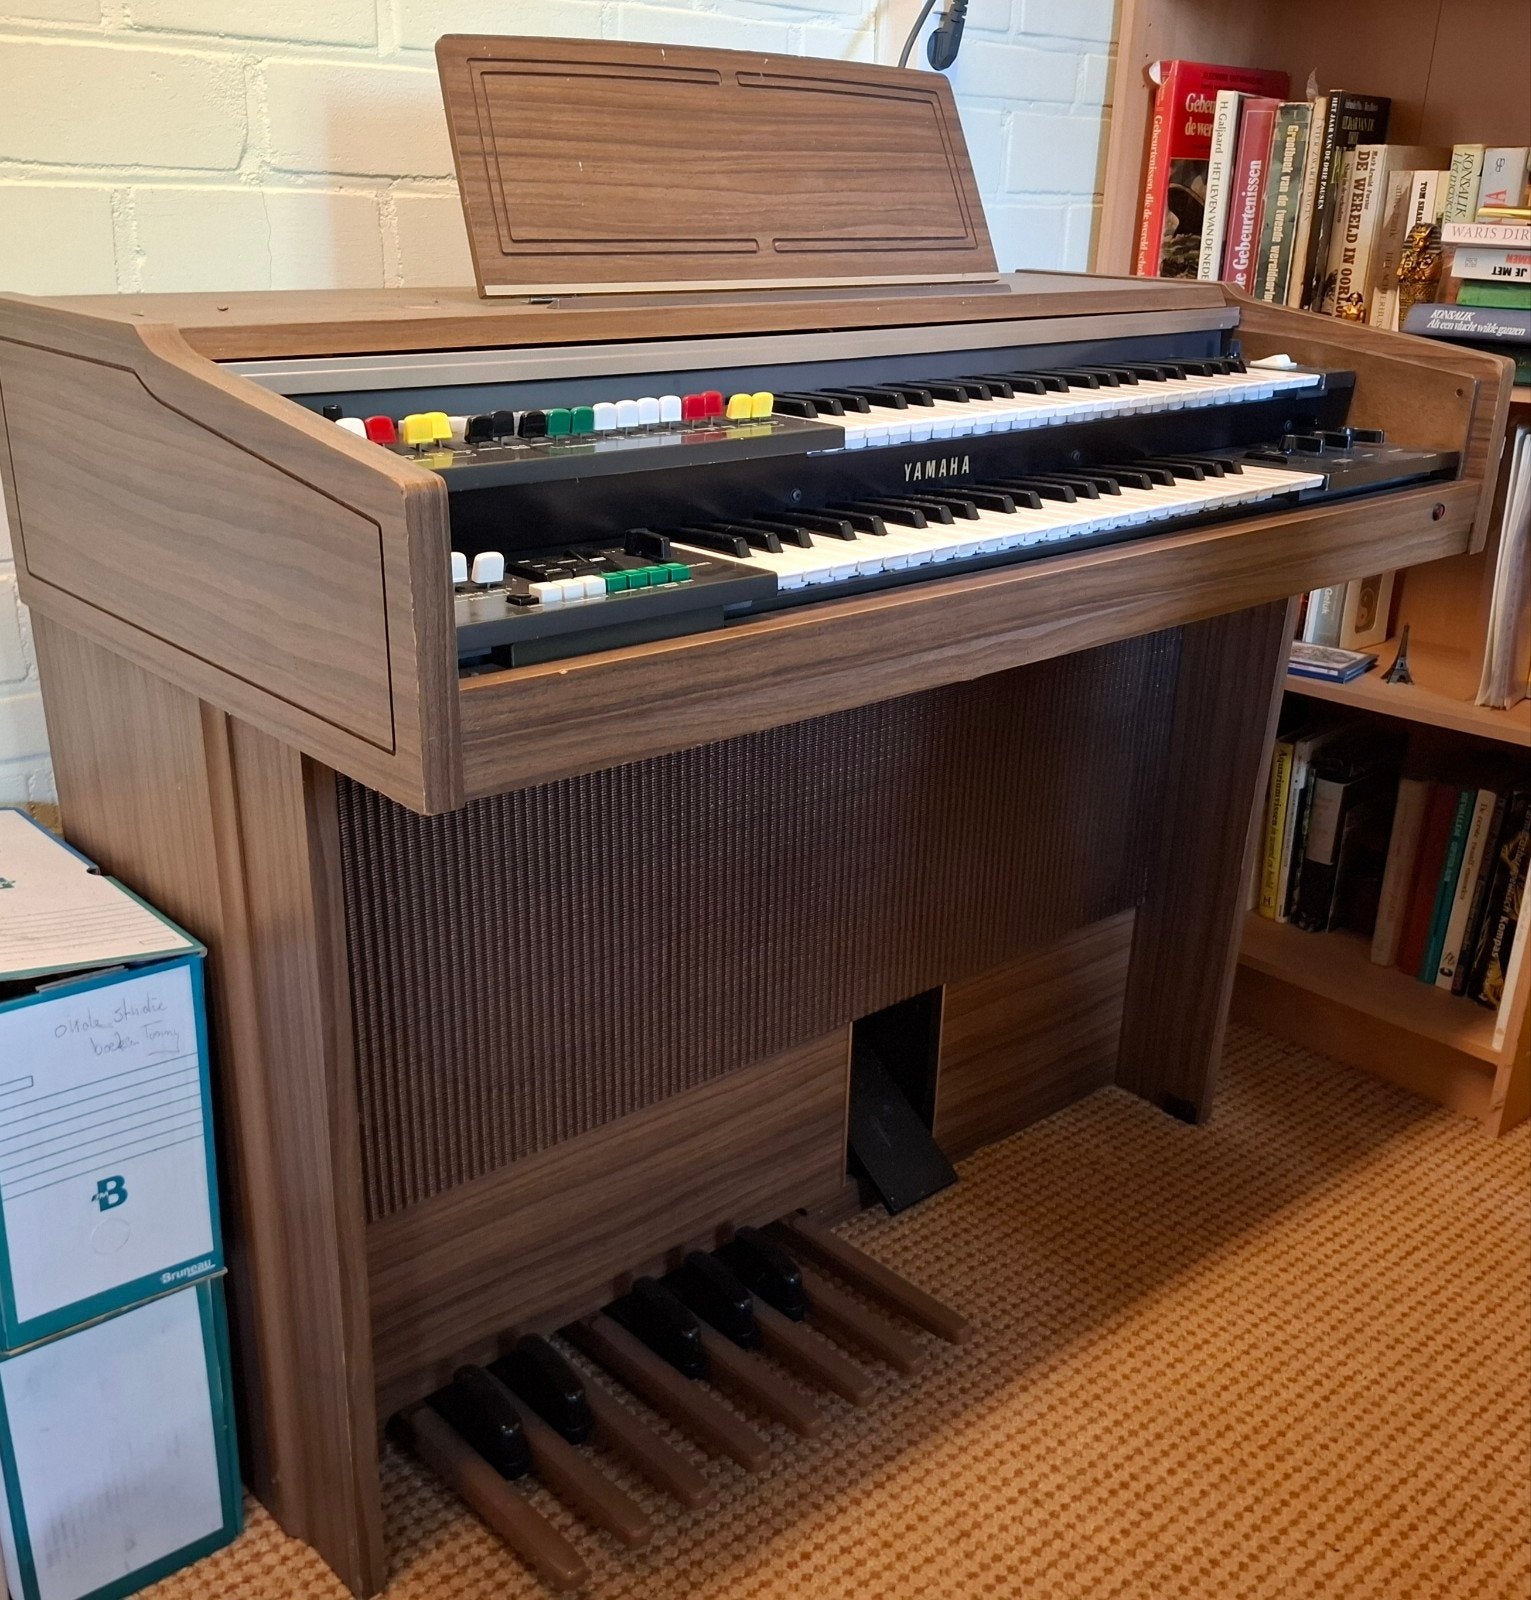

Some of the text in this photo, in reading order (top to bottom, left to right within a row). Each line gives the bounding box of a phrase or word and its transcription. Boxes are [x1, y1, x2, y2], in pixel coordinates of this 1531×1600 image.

[1184, 116, 1196, 135] de
[1215, 113, 1228, 153] Galjaard
[1281, 124, 1299, 173] Grootboek
[1317, 97, 1339, 210] HET JAAR VAN DE DRIE PAUSEN
[1356, 151, 1371, 171] DE
[1452, 153, 1462, 173] Het
[1212, 162, 1222, 181] HET
[1279, 175, 1291, 192] van
[1419, 181, 1428, 199] TOM
[1455, 152, 1474, 217] KONSALIK
[1145, 193, 1154, 208] die
[1209, 184, 1219, 213] LEVEN
[1277, 195, 1289, 206] de
[1143, 209, 1152, 220] de
[1232, 160, 1262, 270] Gebeurtenissen
[1346, 177, 1366, 243] WERELD
[1140, 221, 1149, 250] wereld
[1206, 216, 1216, 236] VAN
[1271, 209, 1287, 242] tweede
[1453, 226, 1498, 239] WARIS
[1204, 238, 1213, 251] DE
[1343, 247, 1357, 265] IN
[1491, 266, 1528, 277] JE MET
[1430, 309, 1476, 321] KONSALIK
[1427, 319, 1526, 336] Als een vlucht wilde ganzen
[904, 455, 970, 481] YAMAHA
[1491, 915, 1510, 958] Kompas
[162, 1259, 216, 1284] Bruneau
